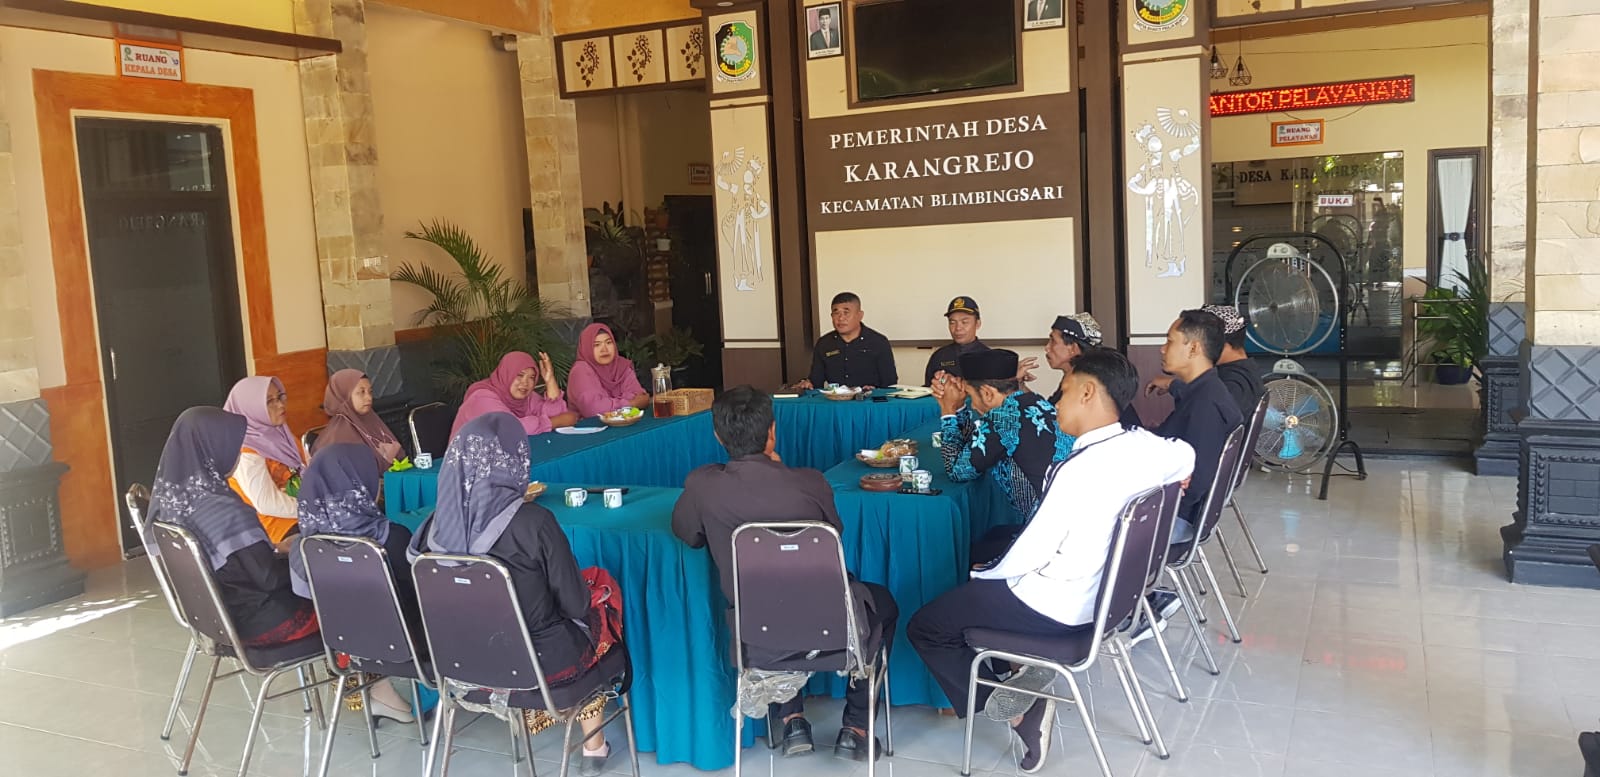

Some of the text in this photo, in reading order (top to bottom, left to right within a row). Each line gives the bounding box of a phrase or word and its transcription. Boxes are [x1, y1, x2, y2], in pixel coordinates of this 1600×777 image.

[136, 53, 168, 64] RUANG
[125, 63, 178, 77] KEPALA DESA
[1279, 80, 1407, 107] PELAYANAN
[830, 114, 1048, 149] PEMERINTAH DESA
[844, 149, 1034, 183] KARANGREJO
[1239, 169, 1272, 183] DESA
[820, 186, 1065, 214] KECAMATAN BLIMBINGSARI
[1320, 197, 1350, 205] BUKA
